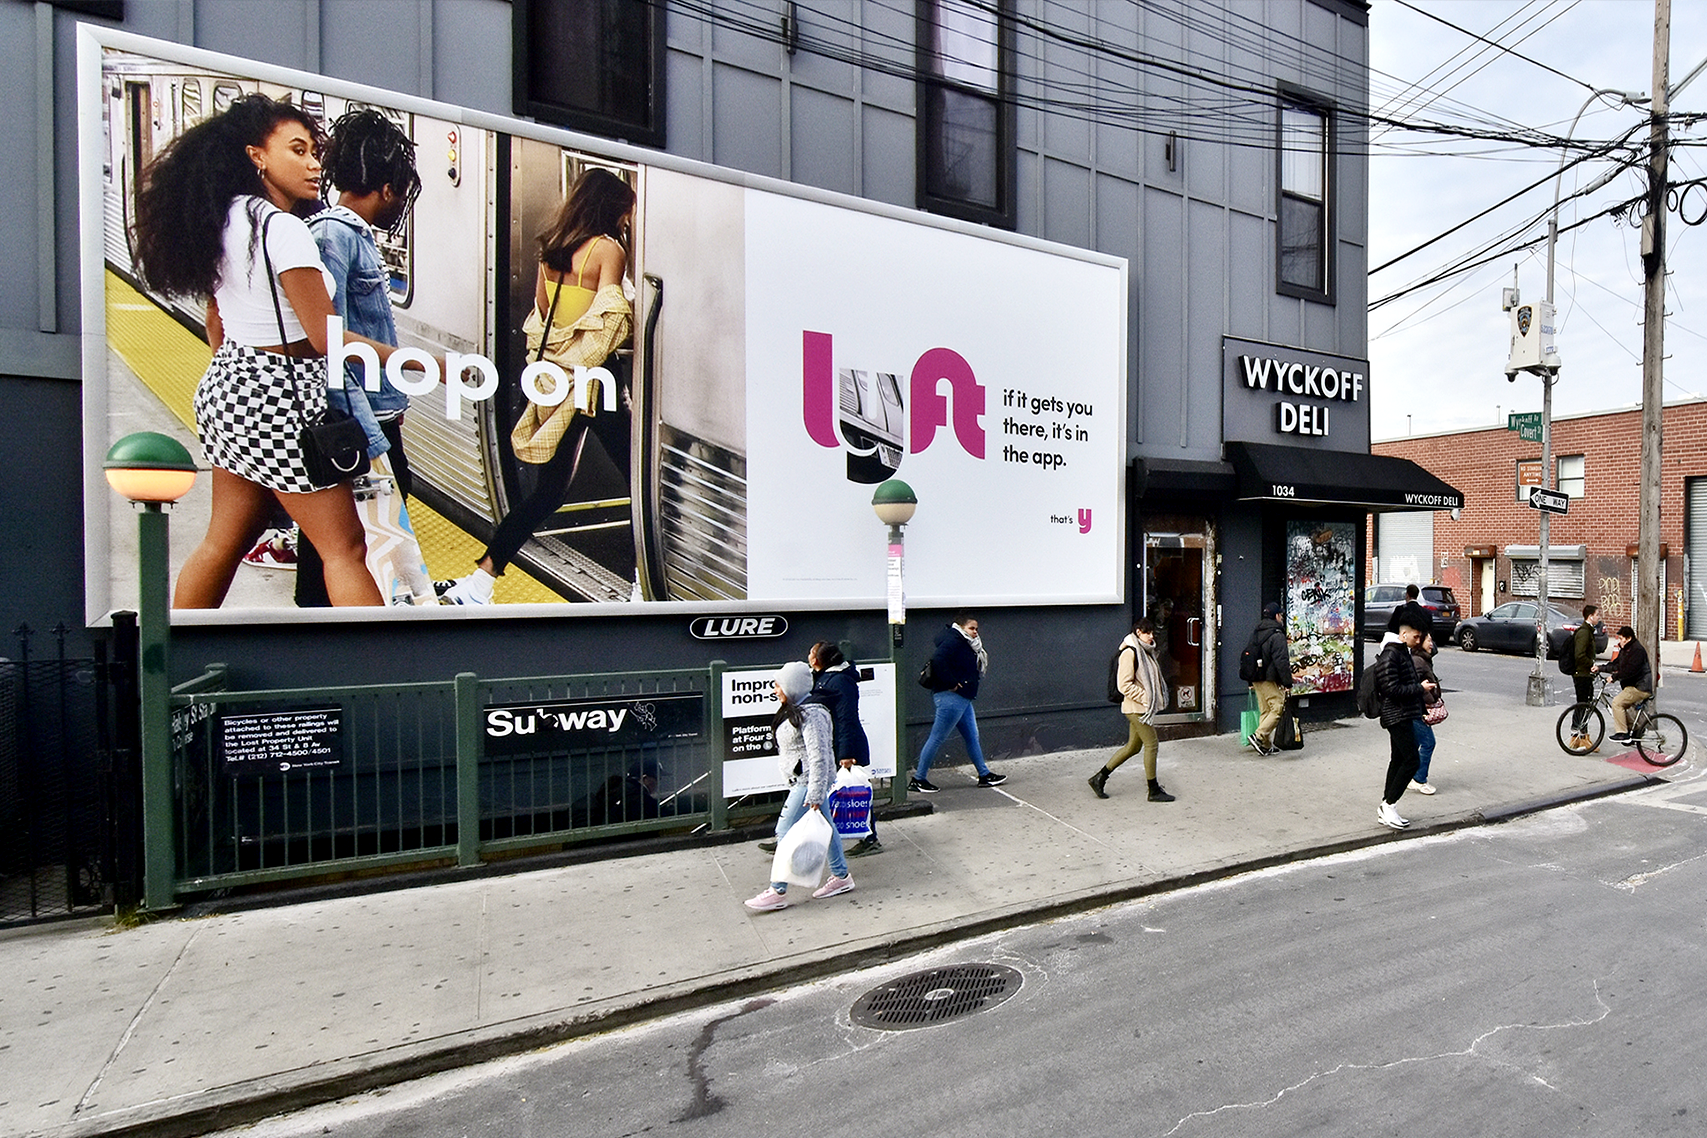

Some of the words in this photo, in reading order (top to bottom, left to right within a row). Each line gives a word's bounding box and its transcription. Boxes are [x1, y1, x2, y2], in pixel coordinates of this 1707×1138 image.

[327, 315, 499, 420] hop
[521, 361, 617, 412] on
[1243, 355, 1363, 401] WYCKOFF
[1002, 389, 1014, 406] if
[1017, 391, 1027, 408] it
[1031, 394, 1063, 415] gets
[1067, 400, 1093, 418] you
[1280, 401, 1329, 435] DELI
[1003, 417, 1048, 440] there,
[1075, 427, 1088, 442] in
[1520, 423, 1537, 439] Covert
[1002, 445, 1029, 463] the
[1032, 452, 1067, 471] app.
[1272, 485, 1295, 497] 1034
[1405, 493, 1442, 506] WYCKOFF
[1443, 496, 1458, 507] DELI
[1534, 494, 1547, 505] ONE
[1552, 498, 1565, 507] WAY
[1077, 508, 1092, 534] y
[703, 618, 776, 636] LURE
[224, 725, 260, 733] attached
[238, 731, 273, 739] removed
[292, 727, 327, 735] delivered
[732, 725, 772, 735] Platform
[732, 736, 742, 744] at
[743, 734, 765, 743] Four
[247, 752, 267, 760] (212)
[270, 747, 331, 758] 712-4500/4501
[745, 743, 762, 751] the
